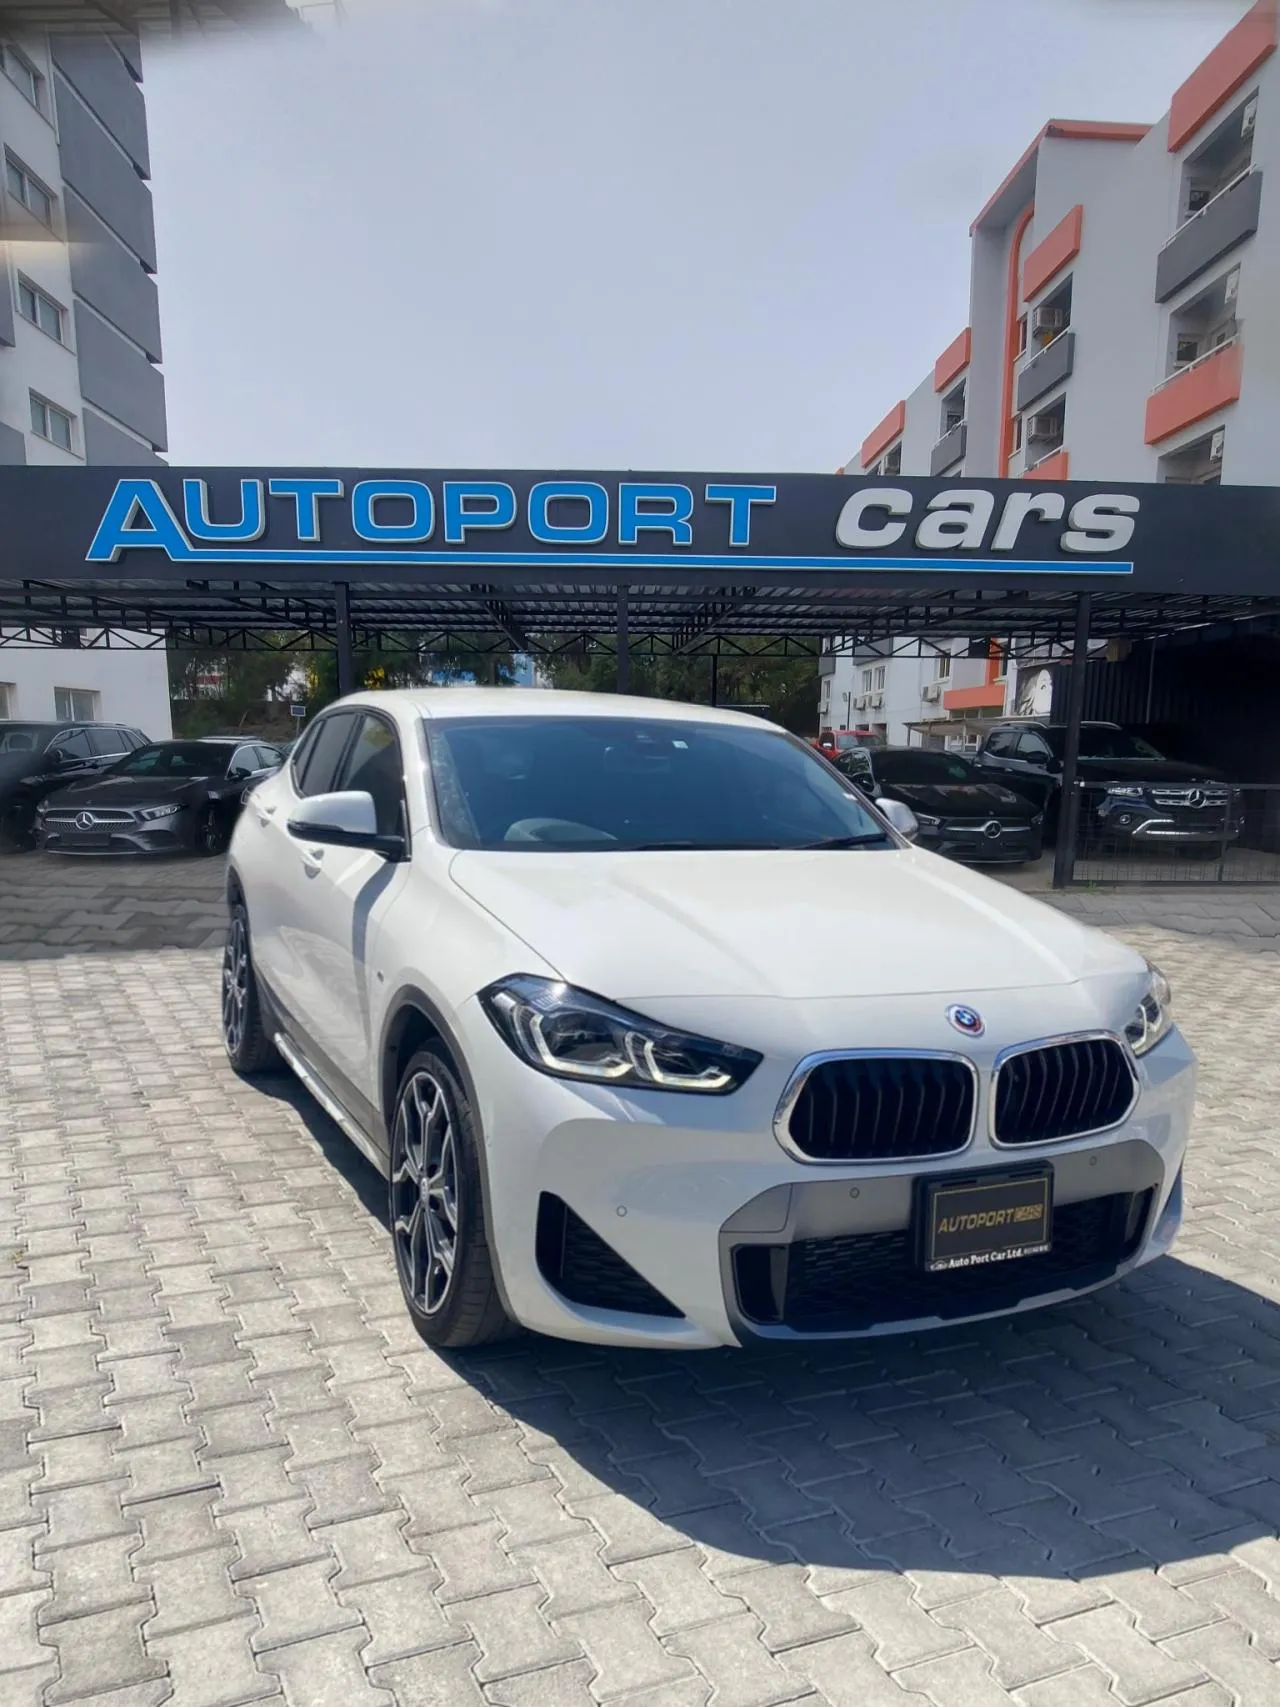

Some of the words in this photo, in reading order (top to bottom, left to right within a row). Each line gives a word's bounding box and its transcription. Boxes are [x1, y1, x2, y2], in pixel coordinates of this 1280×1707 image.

[84, 477, 778, 563] AUTOPORT
[834, 486, 1141, 553] cars
[938, 1208, 1014, 1234] AUTOPORT
[948, 1257, 970, 1269] Auto
[970, 1254, 990, 1265] Port
[990, 1251, 1006, 1261] Car
